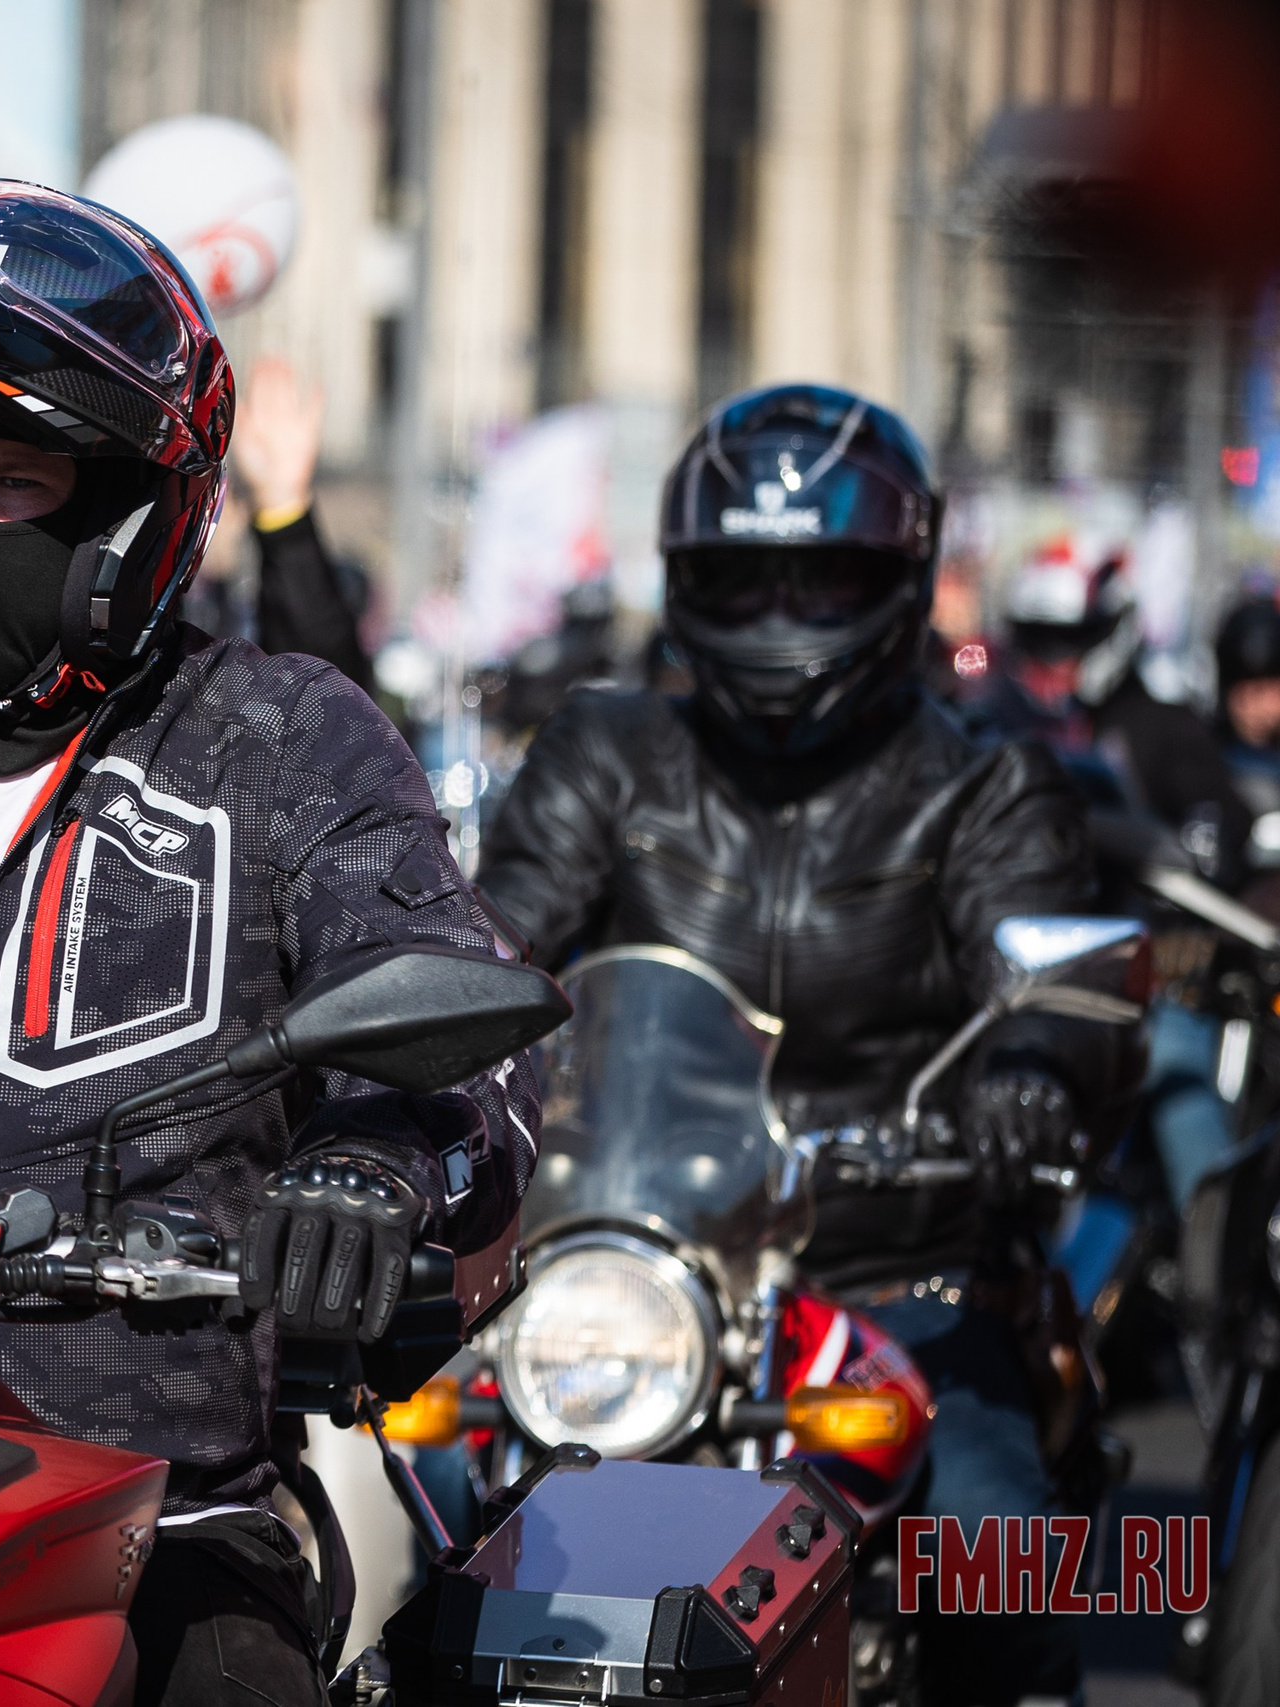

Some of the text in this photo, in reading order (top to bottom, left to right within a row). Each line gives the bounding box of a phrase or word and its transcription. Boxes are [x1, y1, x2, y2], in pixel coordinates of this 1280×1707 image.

[99, 794, 189, 856] MCP
[63, 877, 88, 993] AIR INTAKE SYSTEM
